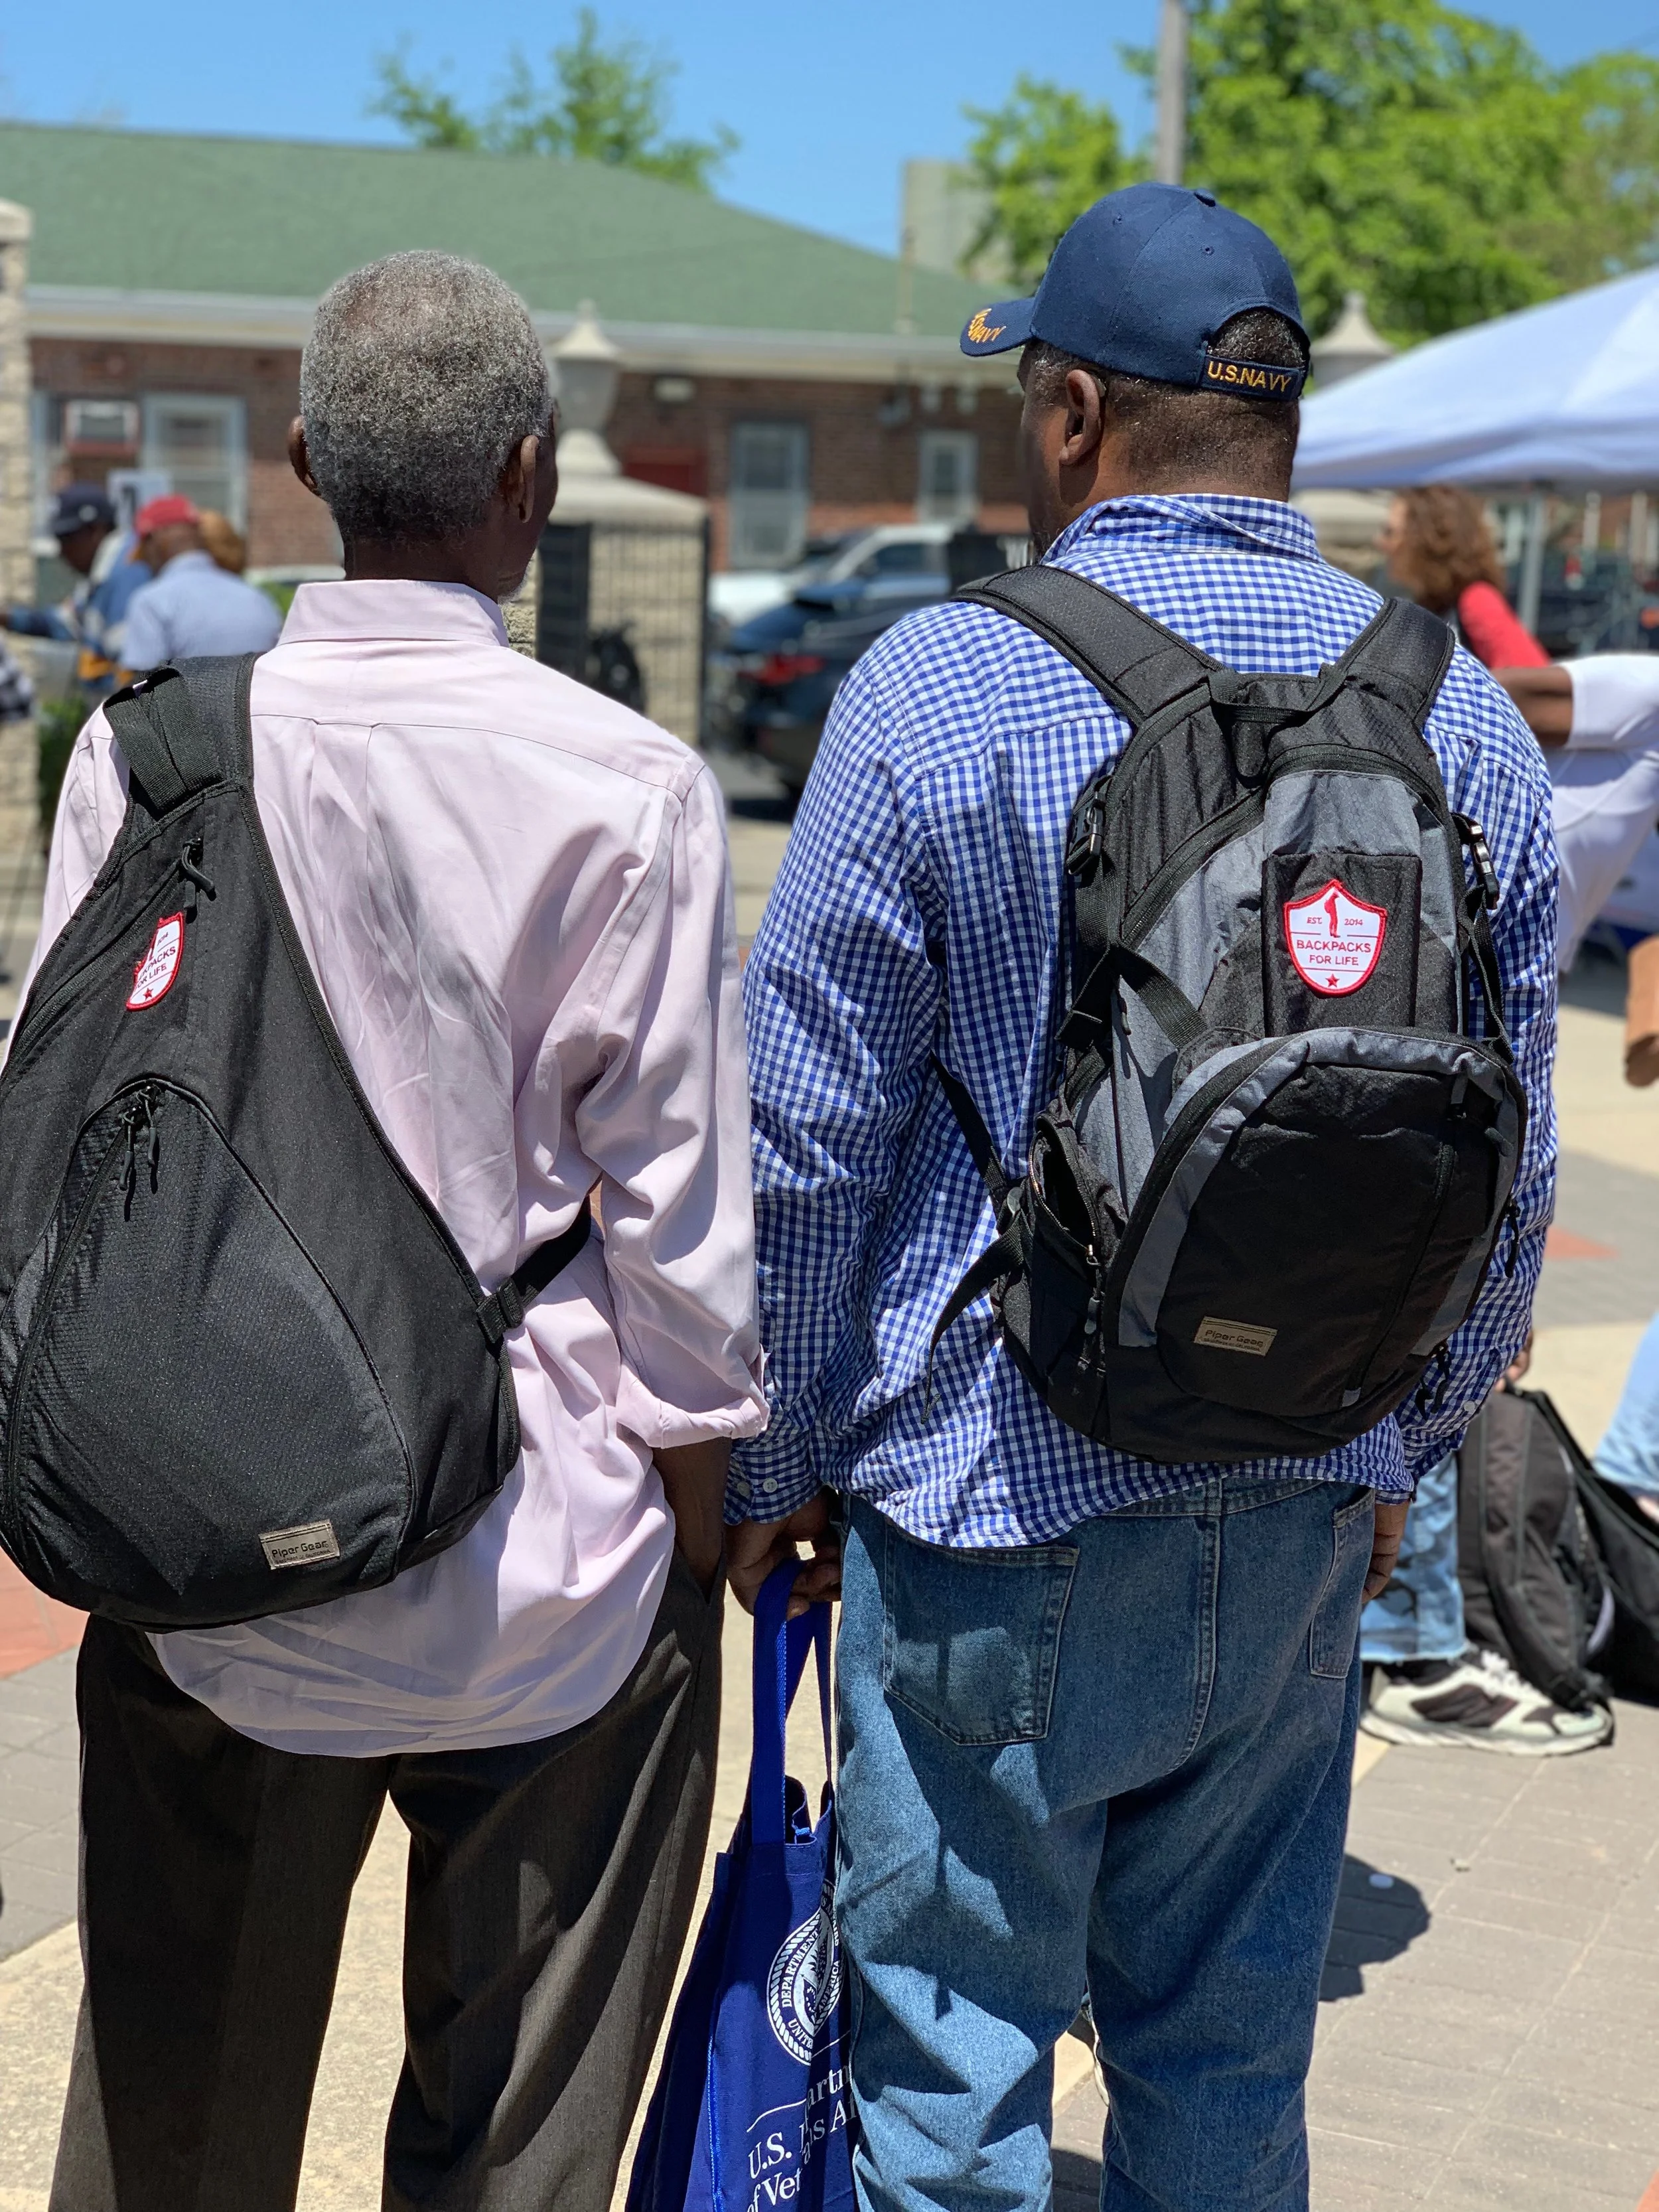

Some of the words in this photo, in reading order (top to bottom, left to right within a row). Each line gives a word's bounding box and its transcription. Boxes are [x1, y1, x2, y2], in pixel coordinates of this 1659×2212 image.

[1296, 940, 1371, 952] BACKPACKS
[1309, 954, 1331, 964] FOR
[1335, 956, 1359, 966] LIFE
[149, 962, 167, 979] LIFE
[1205, 1330, 1235, 1340] Piper
[1236, 1335, 1263, 1347] Gear
[271, 1546, 299, 1558] Piper
[301, 1540, 326, 1552] Gear
[781, 1928, 819, 2008] DEPARTMENT
[748, 2132, 792, 2179] U.S.
